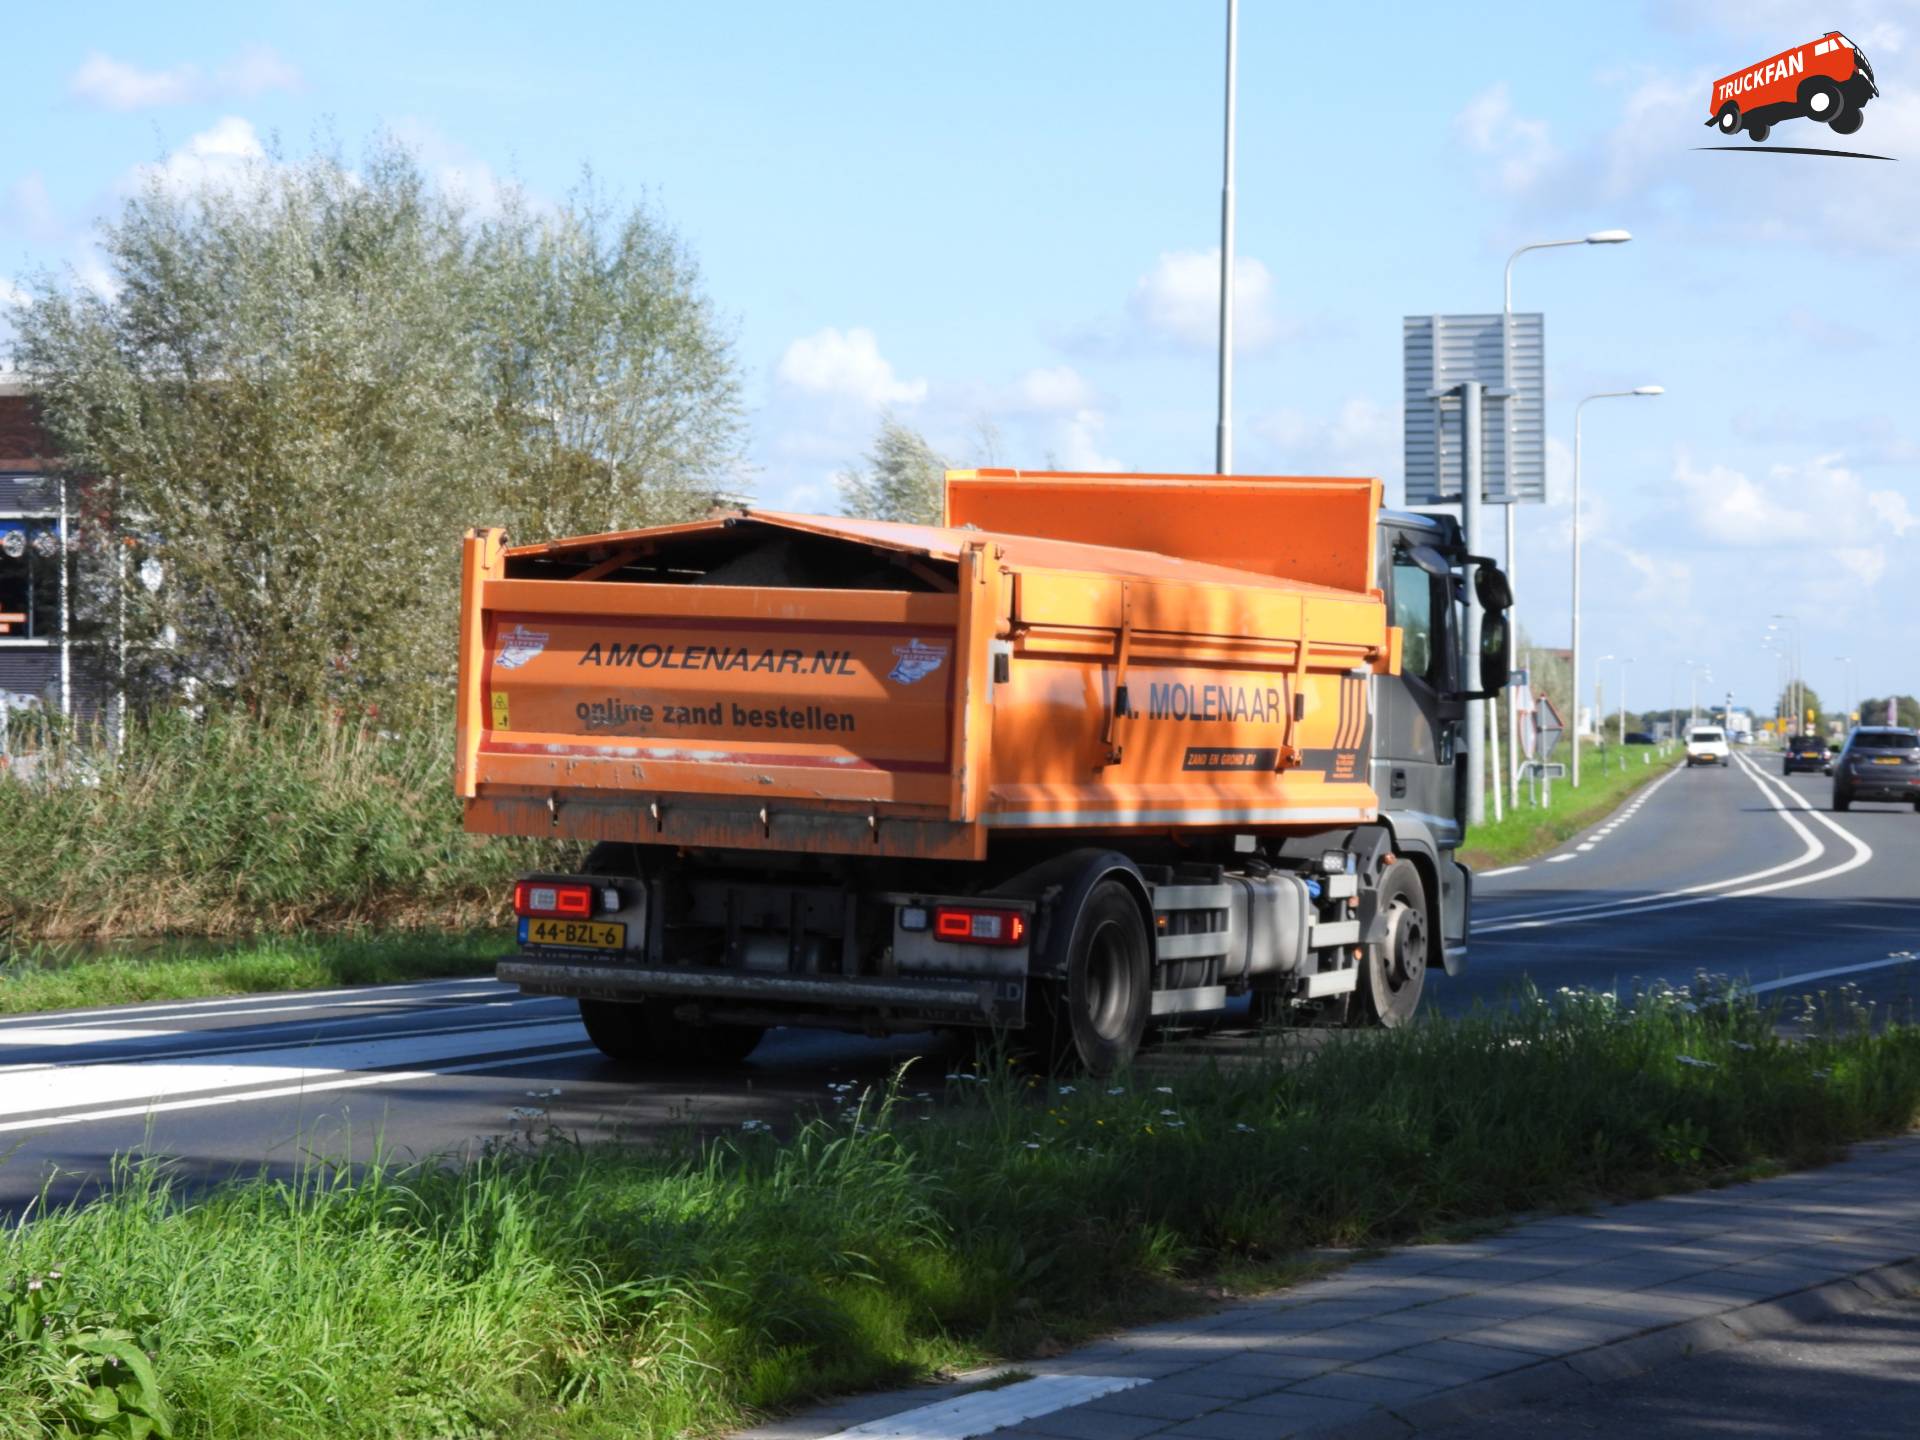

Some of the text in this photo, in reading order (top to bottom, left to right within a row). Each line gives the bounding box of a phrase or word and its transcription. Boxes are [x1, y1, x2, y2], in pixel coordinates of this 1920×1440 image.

[578, 642, 857, 675] AMOLENAAR.NL
[575, 698, 856, 731] online zand bestellen
[1149, 683, 1280, 723] MOLENAAR
[535, 922, 616, 945] 44-BZL-6
